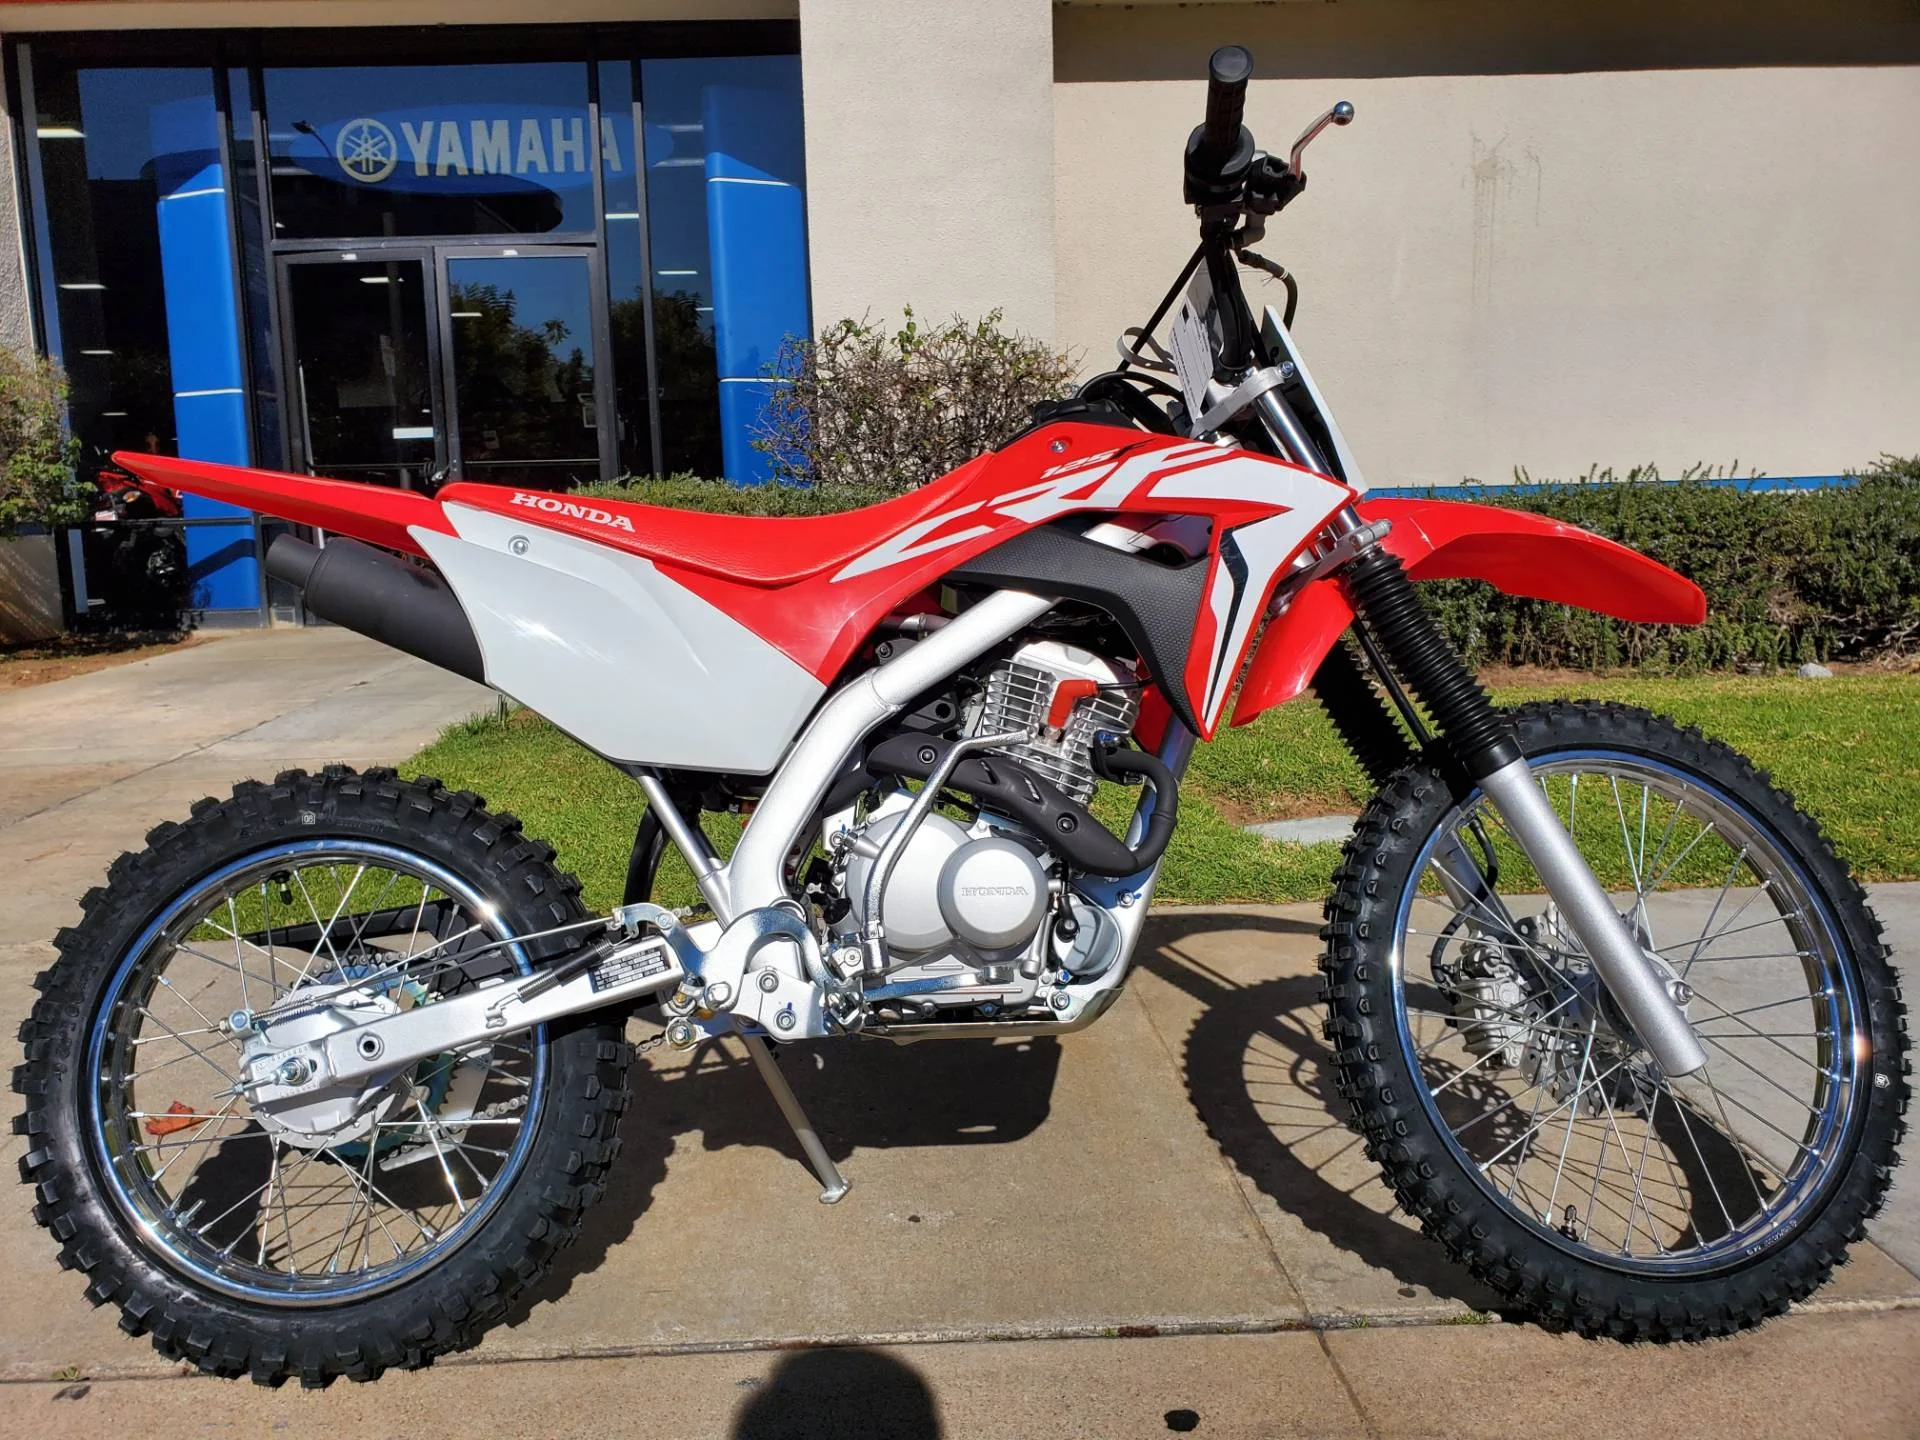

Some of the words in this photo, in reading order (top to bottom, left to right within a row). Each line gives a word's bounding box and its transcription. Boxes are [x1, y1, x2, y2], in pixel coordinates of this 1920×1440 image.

[401, 118, 622, 177] YAMAHA
[1040, 448, 1120, 479] 125
[509, 492, 635, 533] HONDA
[961, 886, 1029, 897] HONDA
